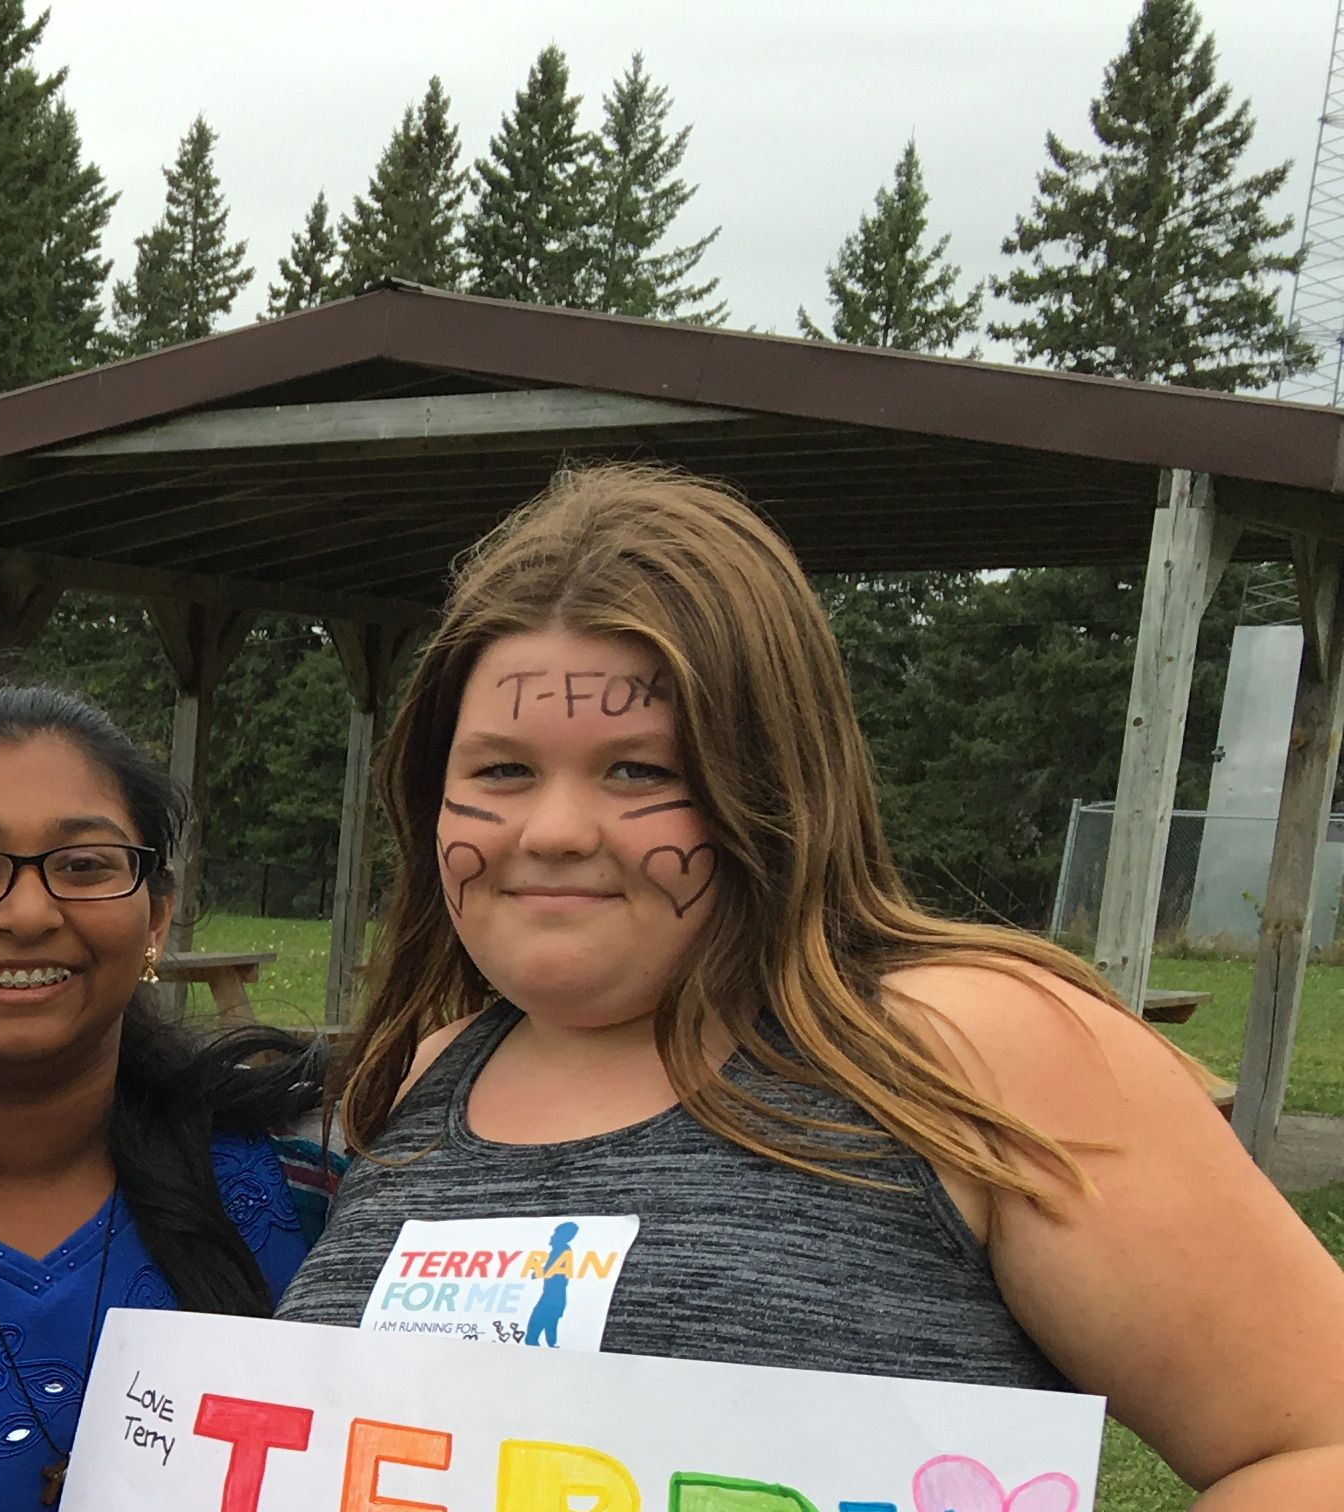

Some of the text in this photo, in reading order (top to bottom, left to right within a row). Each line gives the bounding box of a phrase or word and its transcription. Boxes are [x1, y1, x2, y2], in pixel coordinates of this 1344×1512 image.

[496, 671, 662, 720] T-FOX
[399, 1250, 618, 1279] TERRY RAN
[380, 1282, 525, 1314] FOR ME
[373, 1320, 379, 1331] I
[379, 1321, 398, 1332] AM
[398, 1321, 453, 1334] RUNNING
[124, 1415, 176, 1467] Terry
